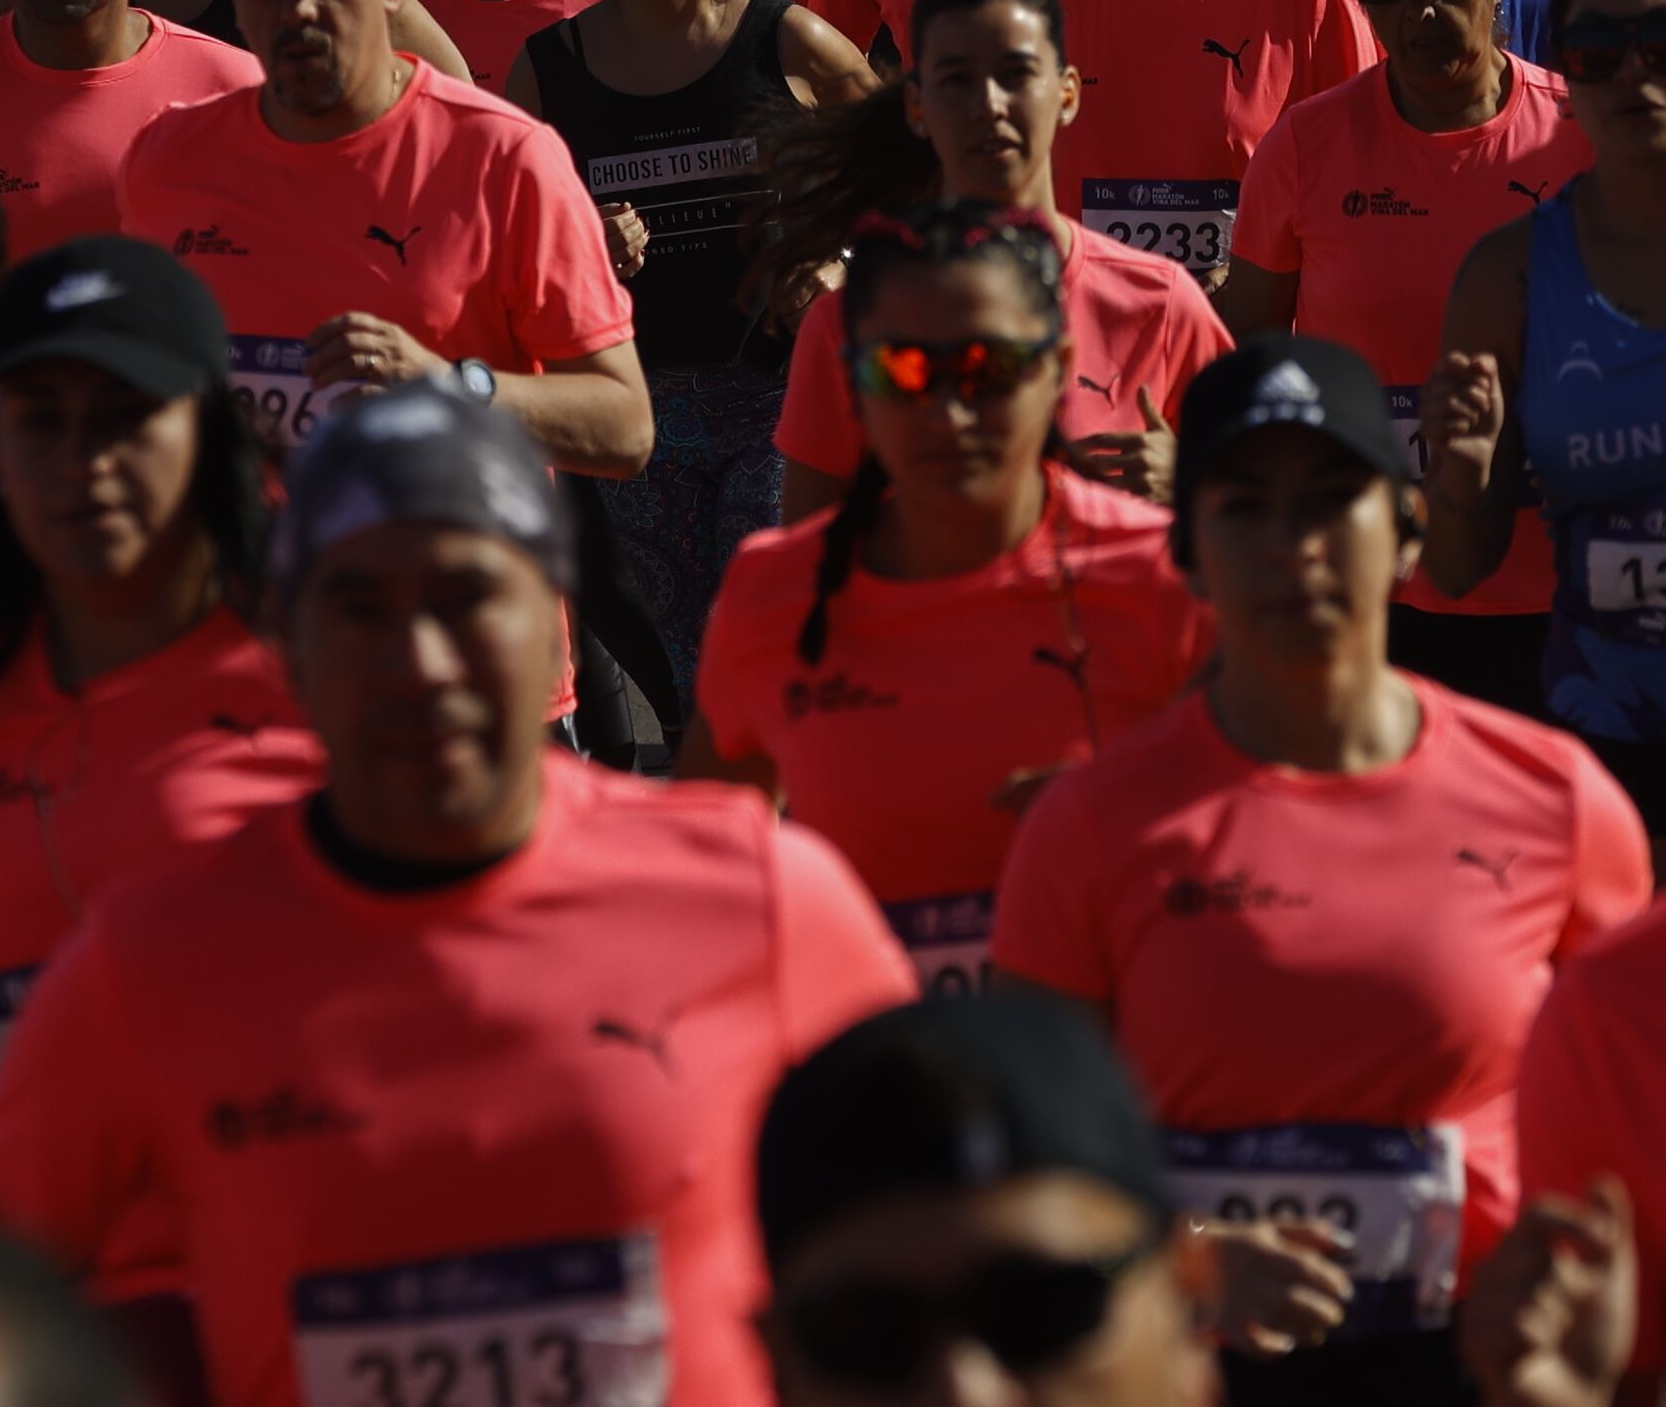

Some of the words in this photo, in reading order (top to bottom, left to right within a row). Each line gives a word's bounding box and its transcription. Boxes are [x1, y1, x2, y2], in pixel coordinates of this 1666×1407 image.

[634, 130, 674, 143] YOURSELF
[678, 126, 701, 137] FIRST
[592, 156, 663, 186] CHOOSE
[669, 152, 692, 175] TO
[698, 145, 757, 171] SHINE
[1106, 222, 1220, 263] 2233
[1391, 395, 1413, 408] 10k
[1568, 422, 1664, 469] RUN
[351, 1329, 586, 1407] 3213
